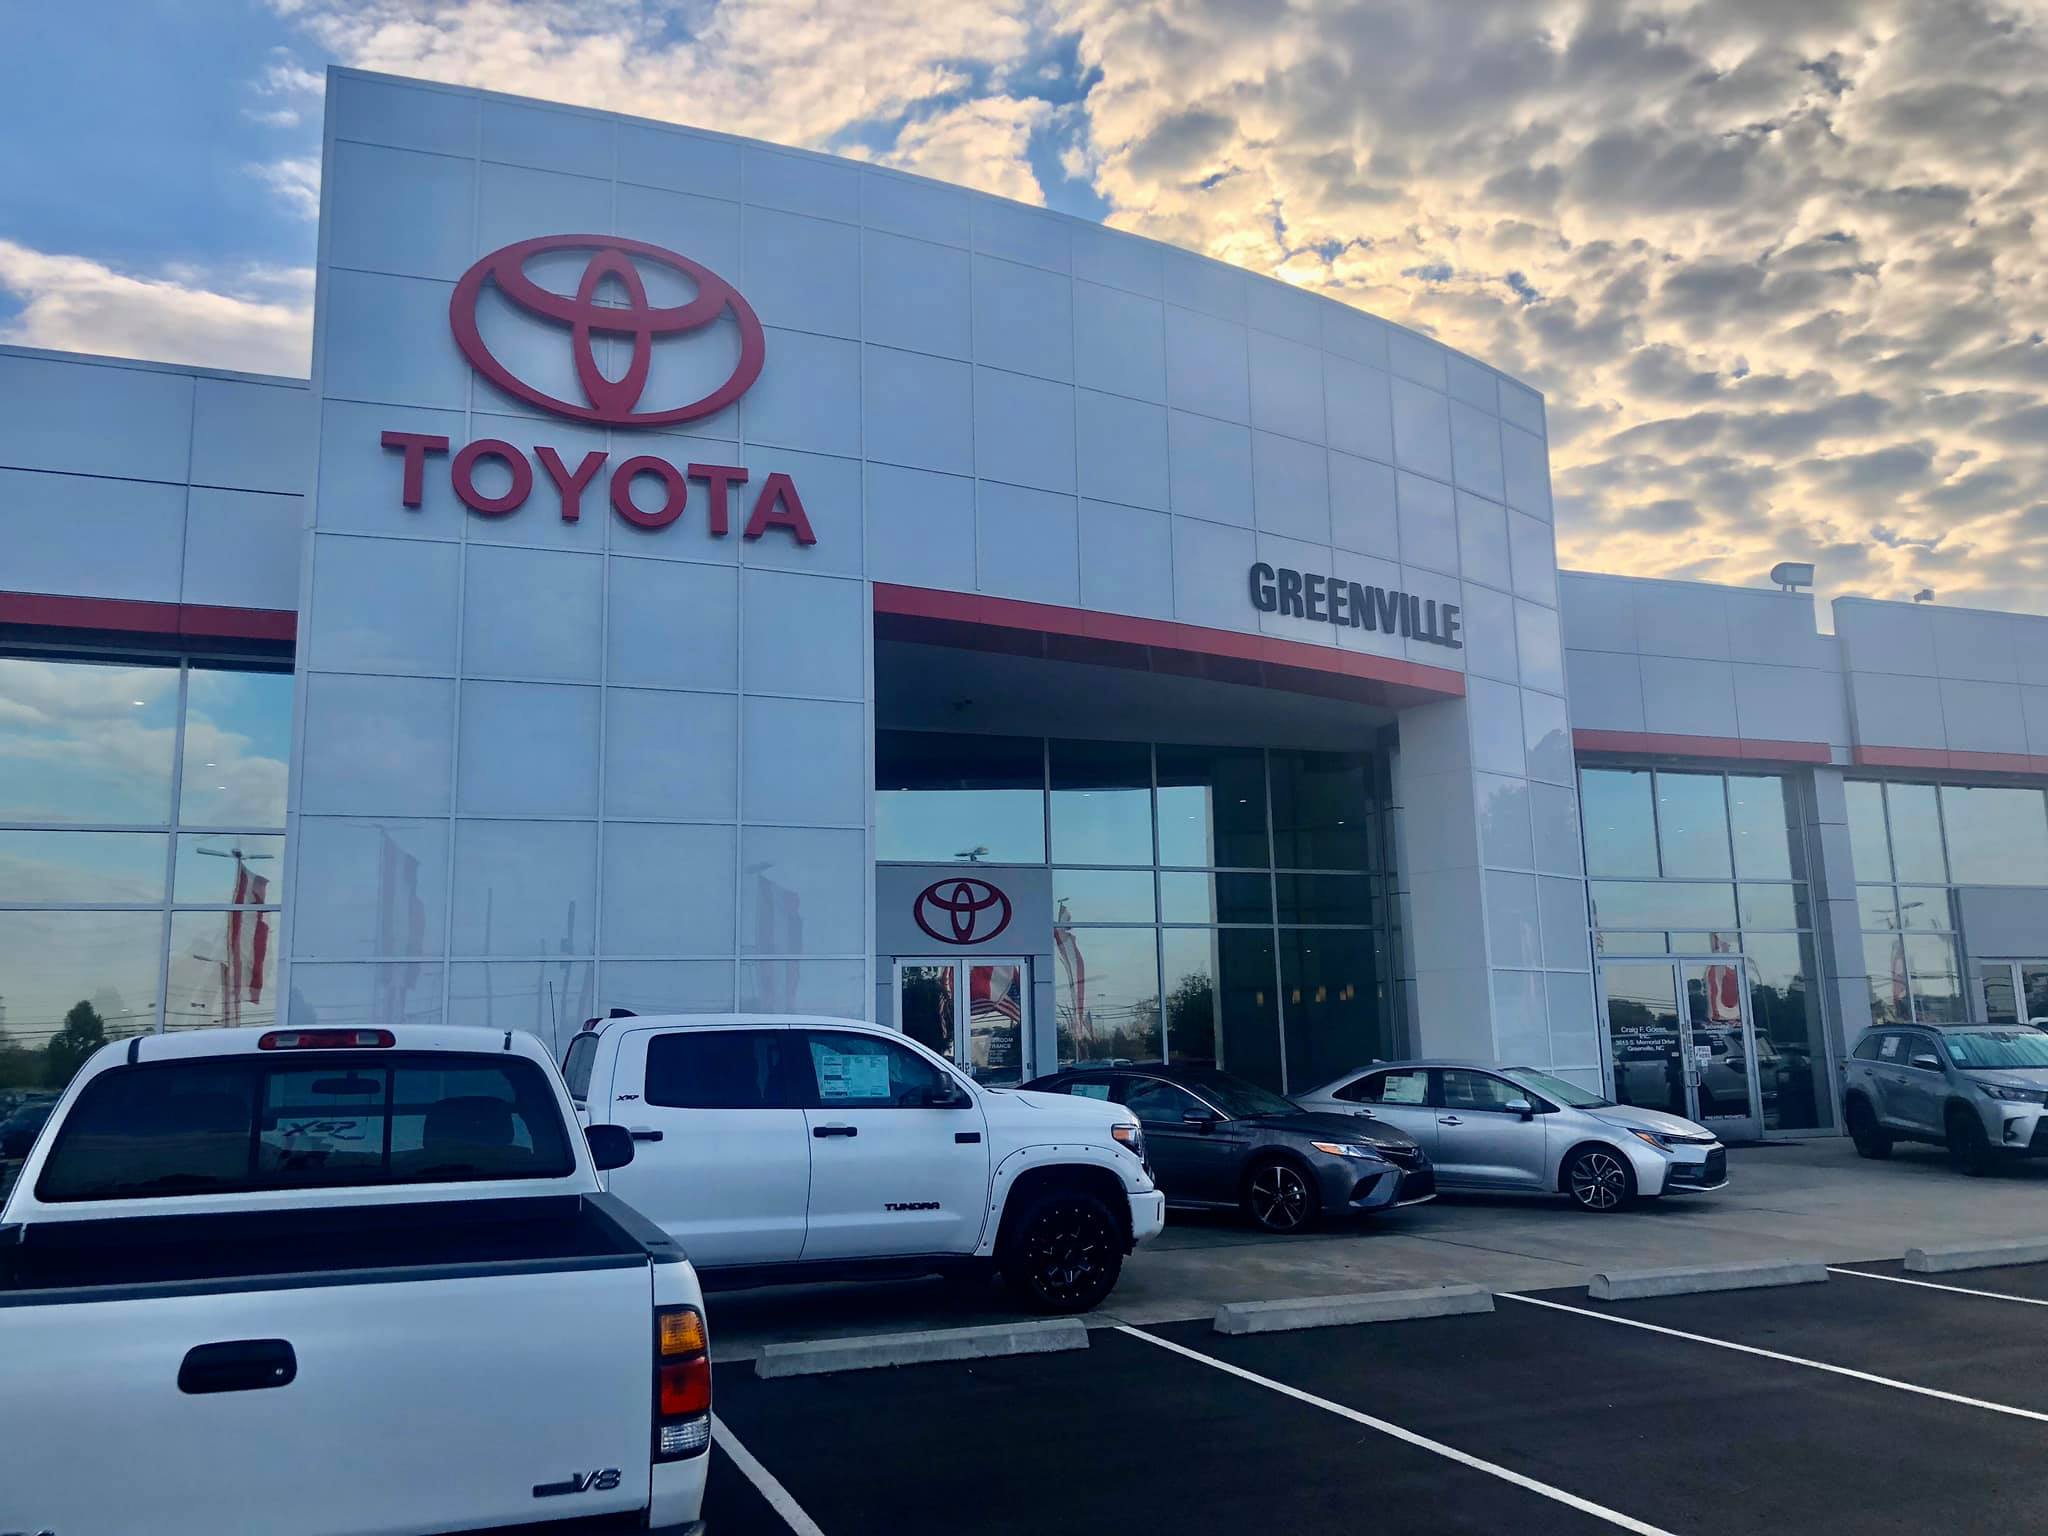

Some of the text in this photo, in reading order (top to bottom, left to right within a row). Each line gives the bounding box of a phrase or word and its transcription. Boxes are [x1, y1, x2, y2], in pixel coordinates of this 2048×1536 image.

[381, 430, 817, 545] TOYOTA
[1249, 562, 1463, 649] GREENVILLE
[884, 1201, 941, 1211] TUNDRA
[573, 1467, 622, 1493] V8
